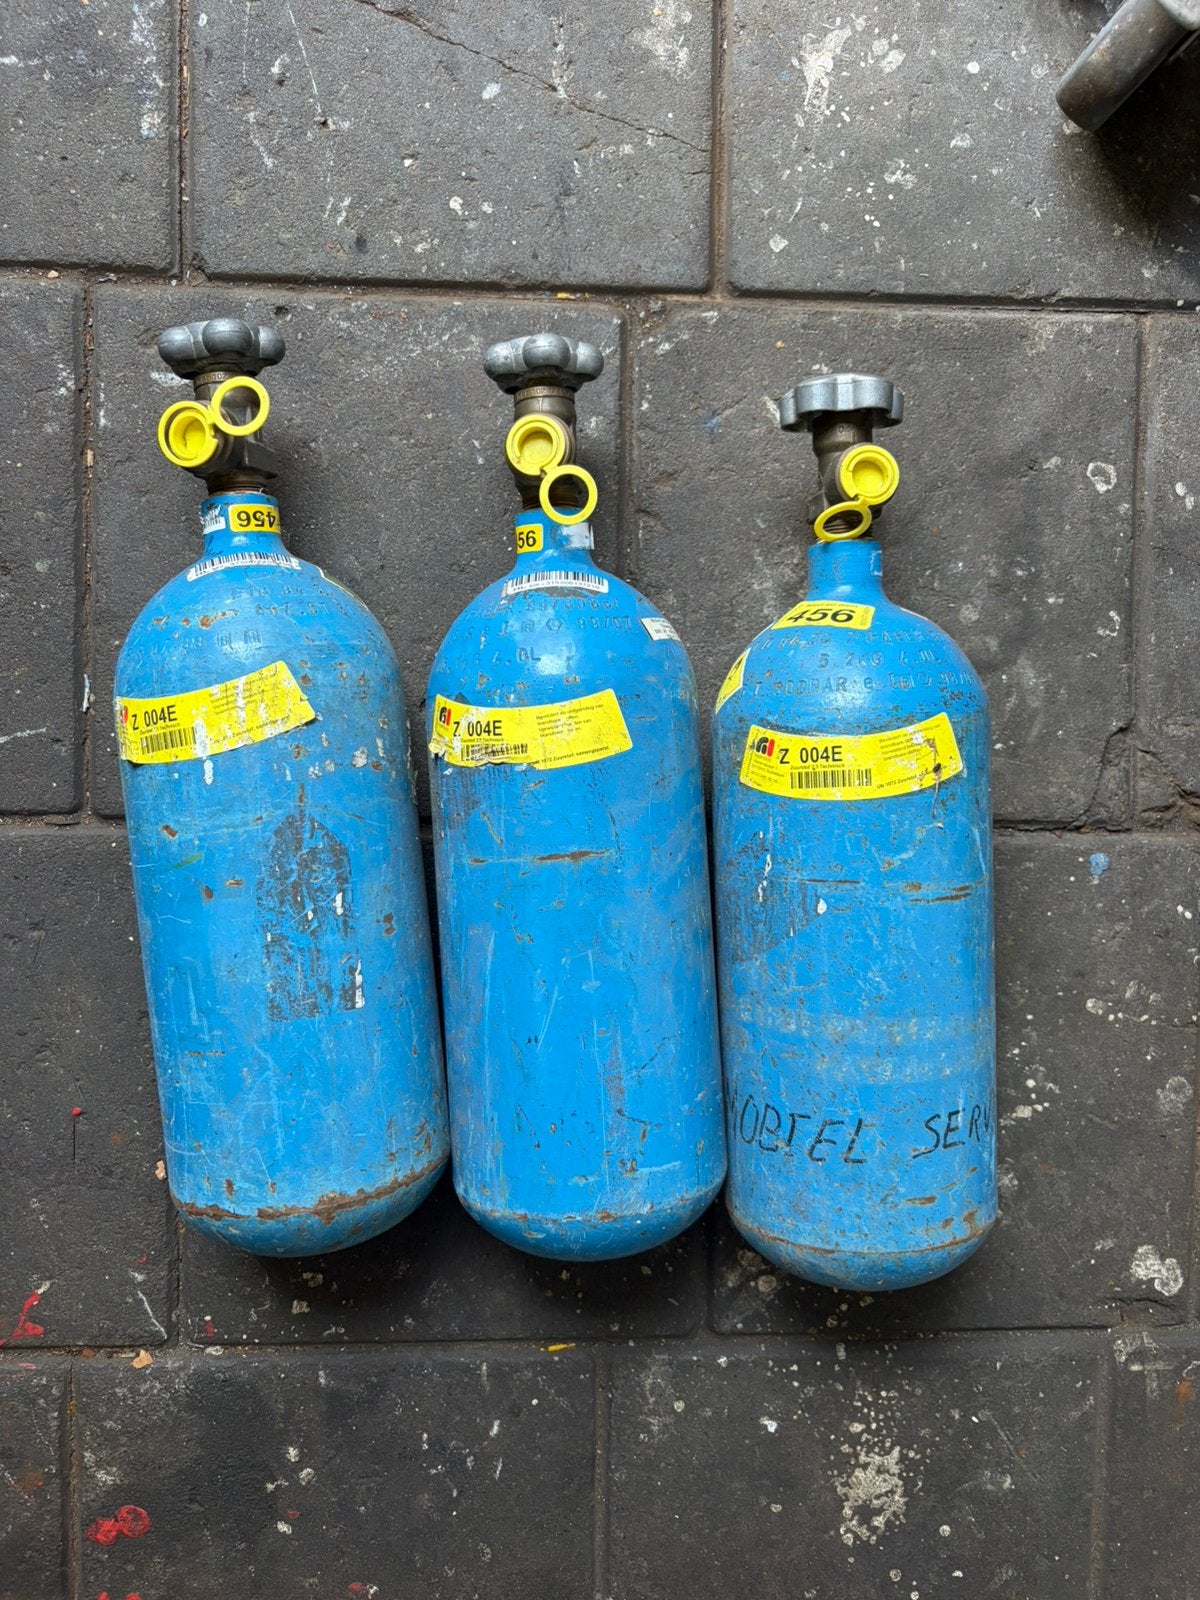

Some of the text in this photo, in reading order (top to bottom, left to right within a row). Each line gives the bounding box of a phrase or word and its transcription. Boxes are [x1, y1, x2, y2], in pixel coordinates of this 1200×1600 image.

[236, 510, 276, 528] 456
[786, 608, 857, 623] 456
[131, 713, 140, 731] Z
[143, 704, 178, 728] 004E
[453, 720, 503, 737] Z 004E
[780, 745, 843, 765] Z 004E
